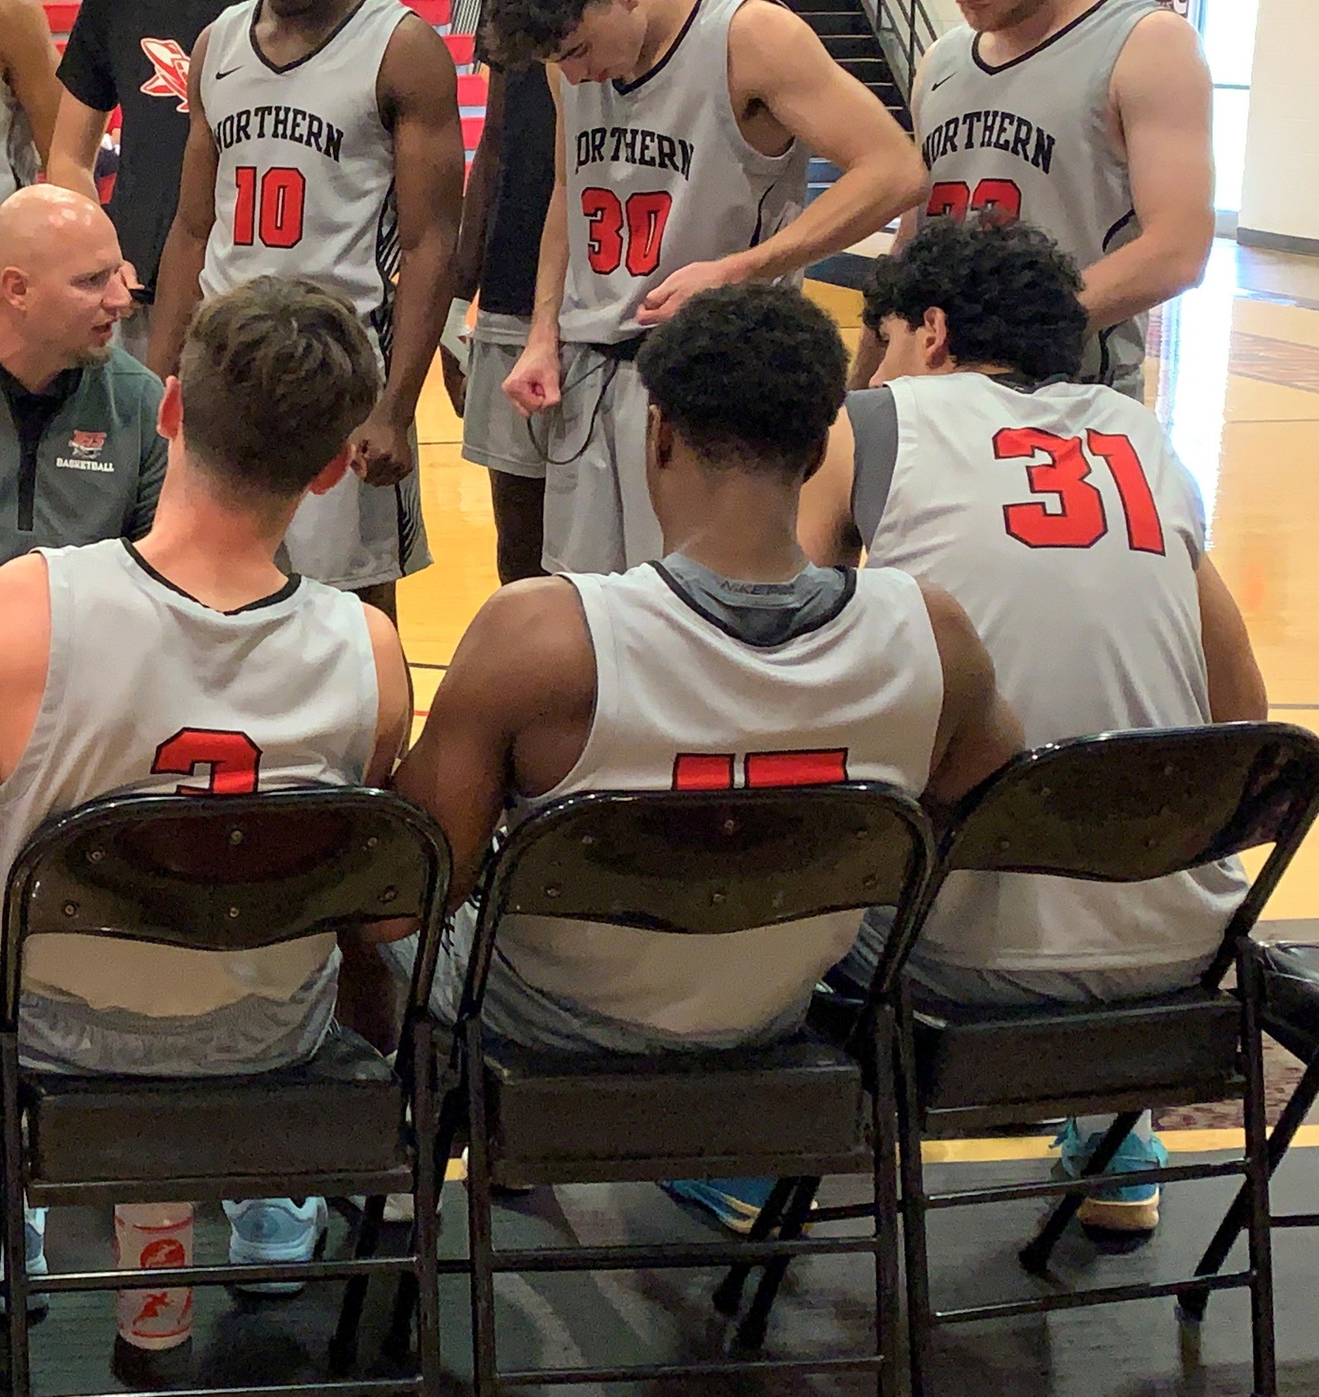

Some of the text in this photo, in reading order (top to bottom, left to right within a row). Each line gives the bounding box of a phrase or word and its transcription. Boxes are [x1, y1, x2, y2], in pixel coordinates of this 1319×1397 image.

[575, 127, 695, 181] ORTHERN
[922, 110, 1056, 174] NORTHERN
[234, 166, 306, 249] 10
[581, 187, 672, 277] 30
[56, 457, 115, 472] BASKETBALL
[993, 427, 1166, 556] 31
